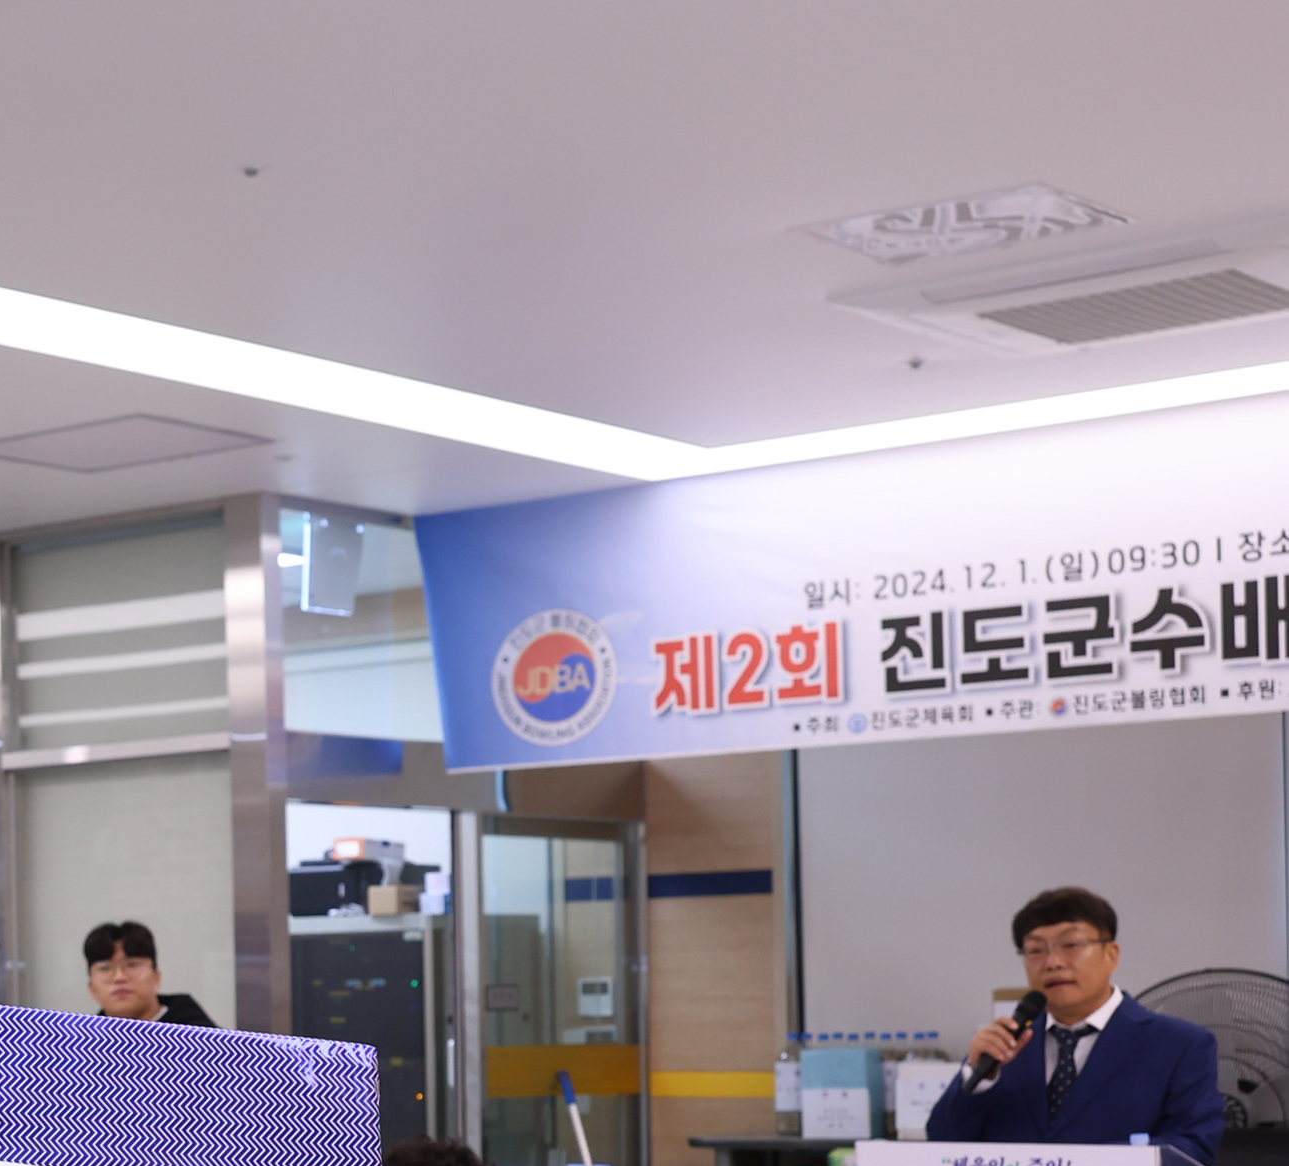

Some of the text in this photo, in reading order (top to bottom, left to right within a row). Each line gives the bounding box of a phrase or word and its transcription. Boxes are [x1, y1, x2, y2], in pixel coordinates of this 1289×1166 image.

[804, 577, 862, 610] 일시:
[653, 573, 1289, 712] 제2회 진도군수배
[515, 662, 591, 697] JDBA
[1073, 685, 1206, 715] 진도군볼링협회
